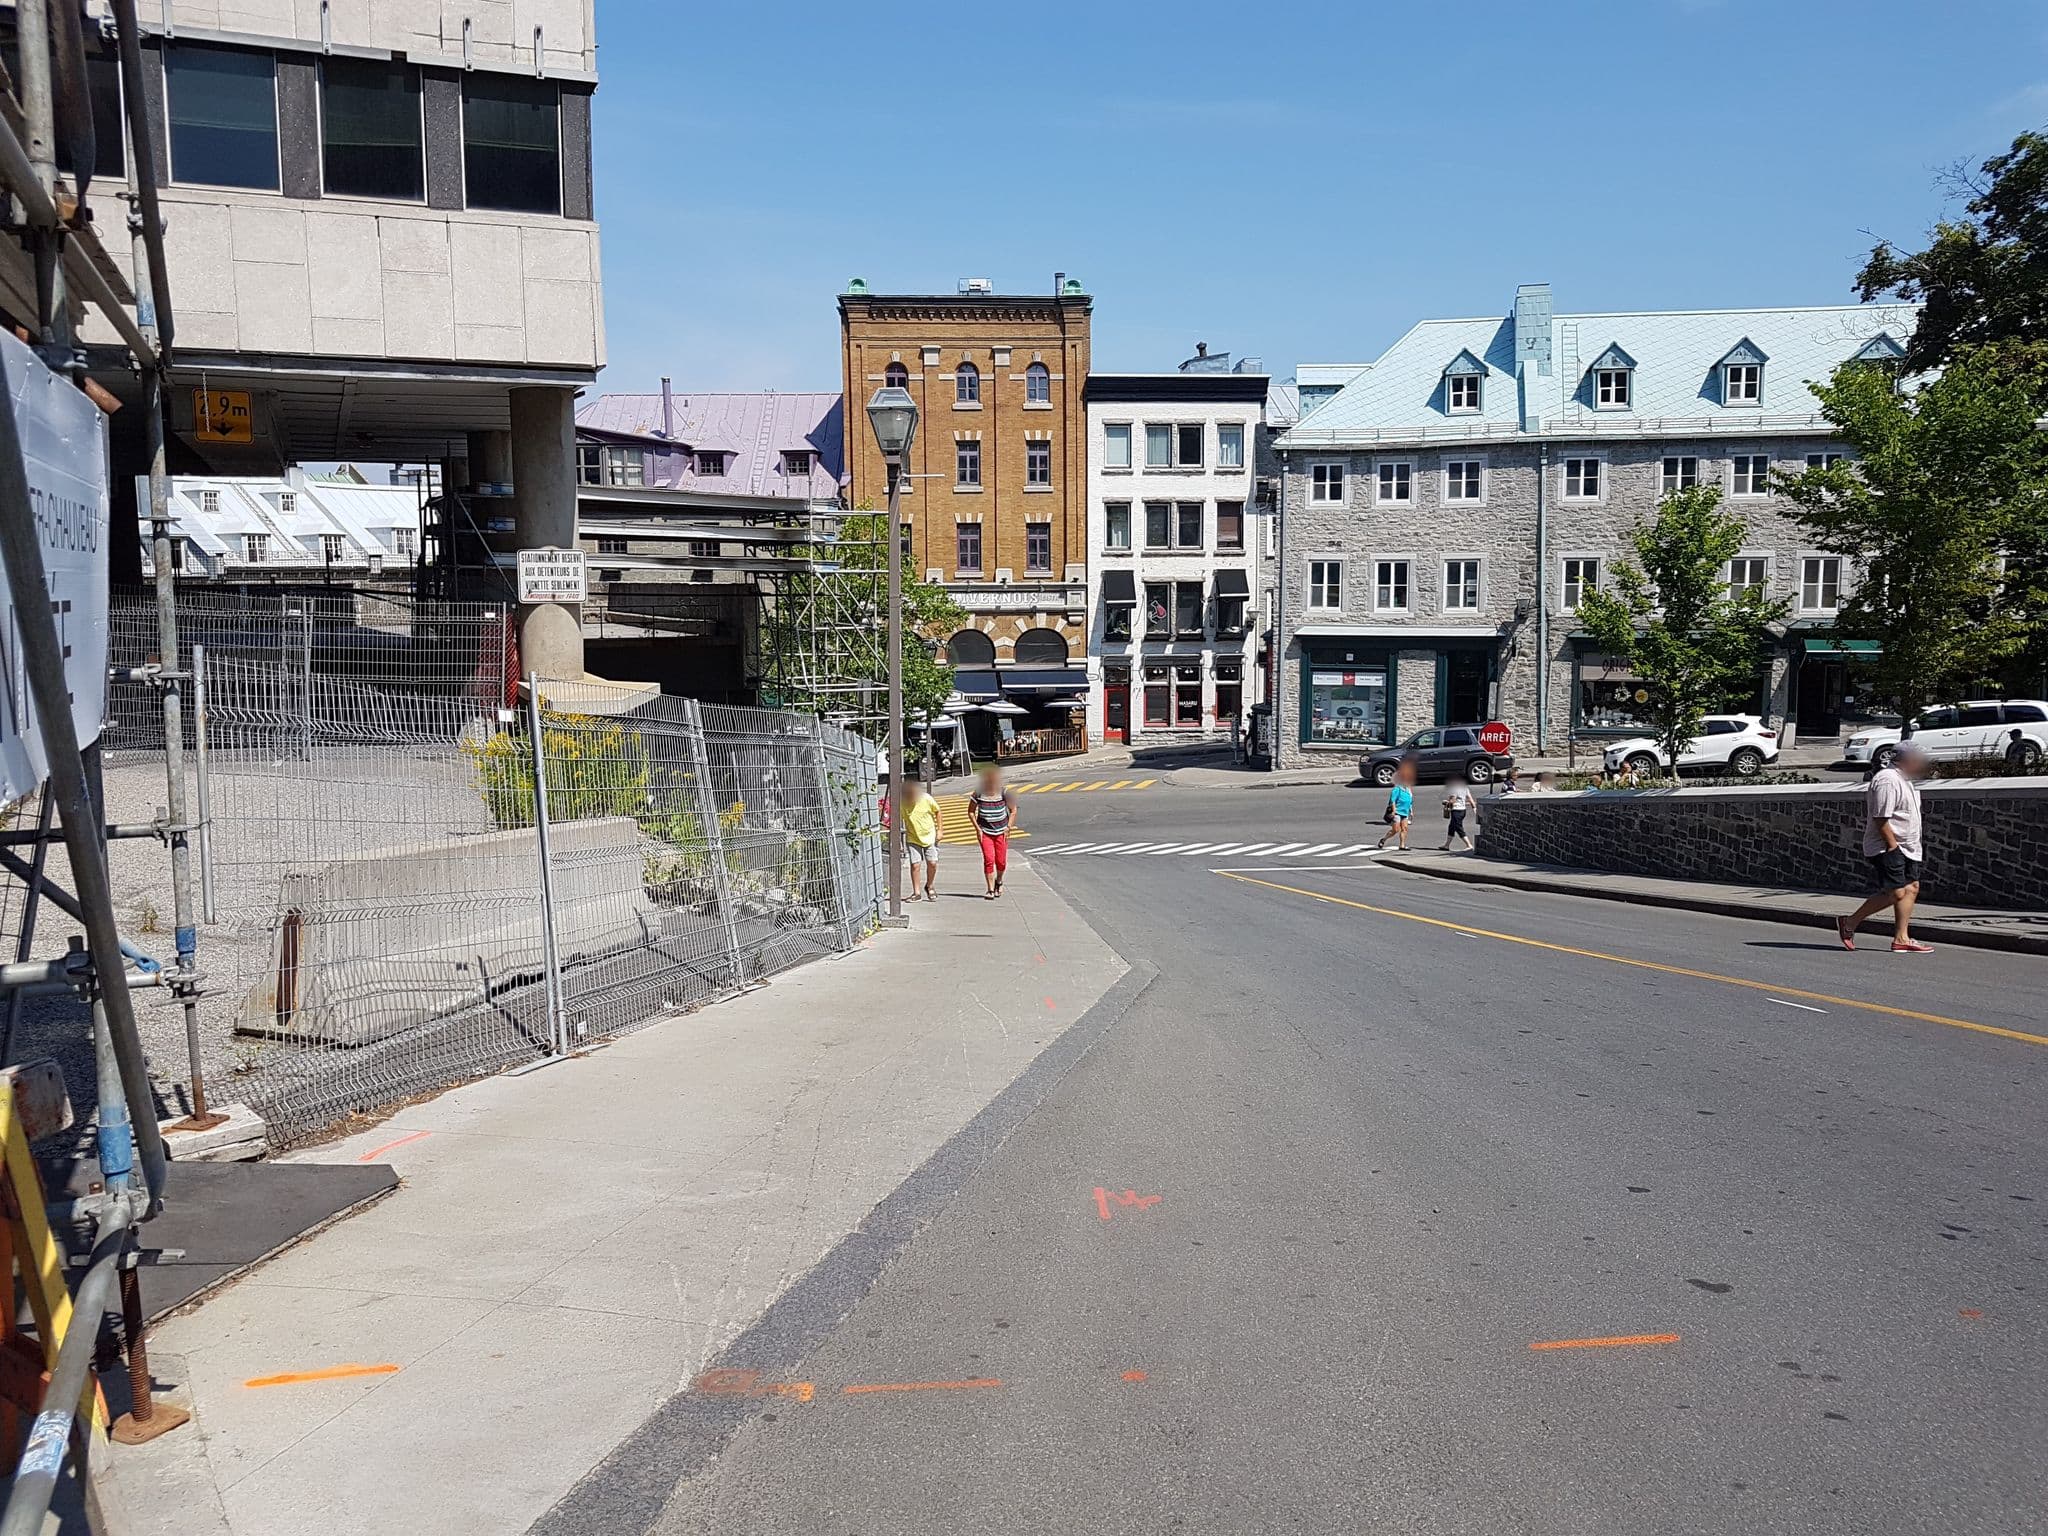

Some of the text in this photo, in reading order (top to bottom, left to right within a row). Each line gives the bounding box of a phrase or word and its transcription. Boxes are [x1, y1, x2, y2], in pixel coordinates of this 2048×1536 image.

[521, 553, 560, 564] STATIONNEMENT
[525, 566, 536, 577] AUX
[573, 566, 580, 577] DE
[1480, 731, 1510, 743] ARRÊT
